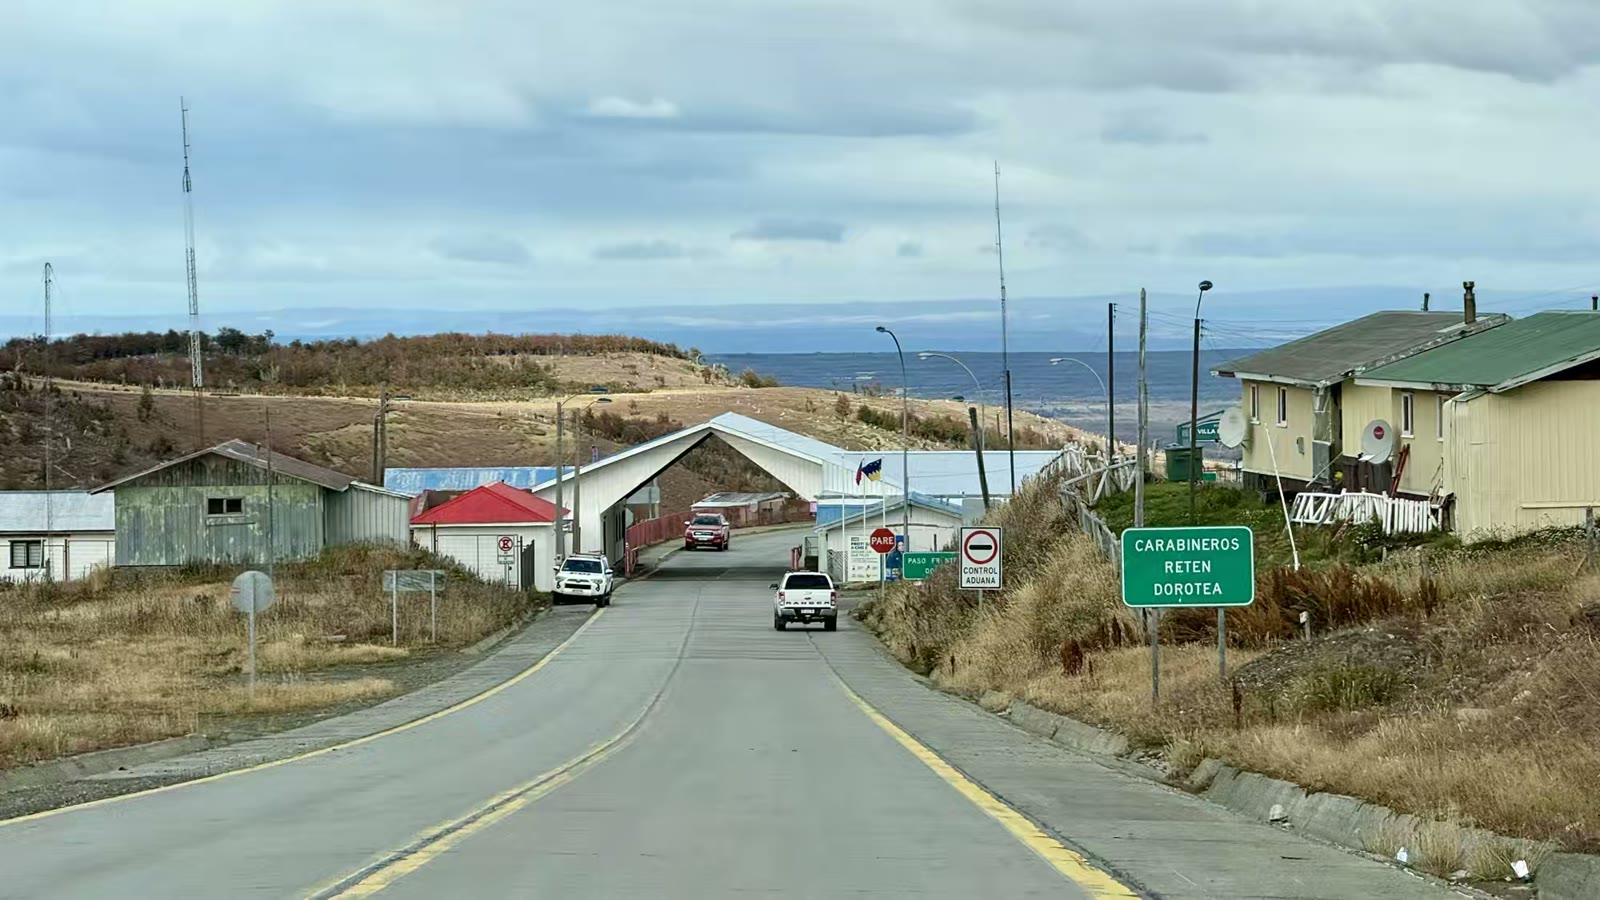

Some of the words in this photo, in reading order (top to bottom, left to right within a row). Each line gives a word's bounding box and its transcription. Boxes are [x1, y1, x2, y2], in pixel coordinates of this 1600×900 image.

[871, 536, 895, 545] PARE
[1135, 537, 1240, 552] CARABINEROS
[907, 557, 927, 565] PASO
[963, 566, 998, 575] CONTROL
[1164, 560, 1212, 573] RETEN
[966, 576, 996, 584] ADUANA
[1153, 582, 1223, 596] DOROTEA
